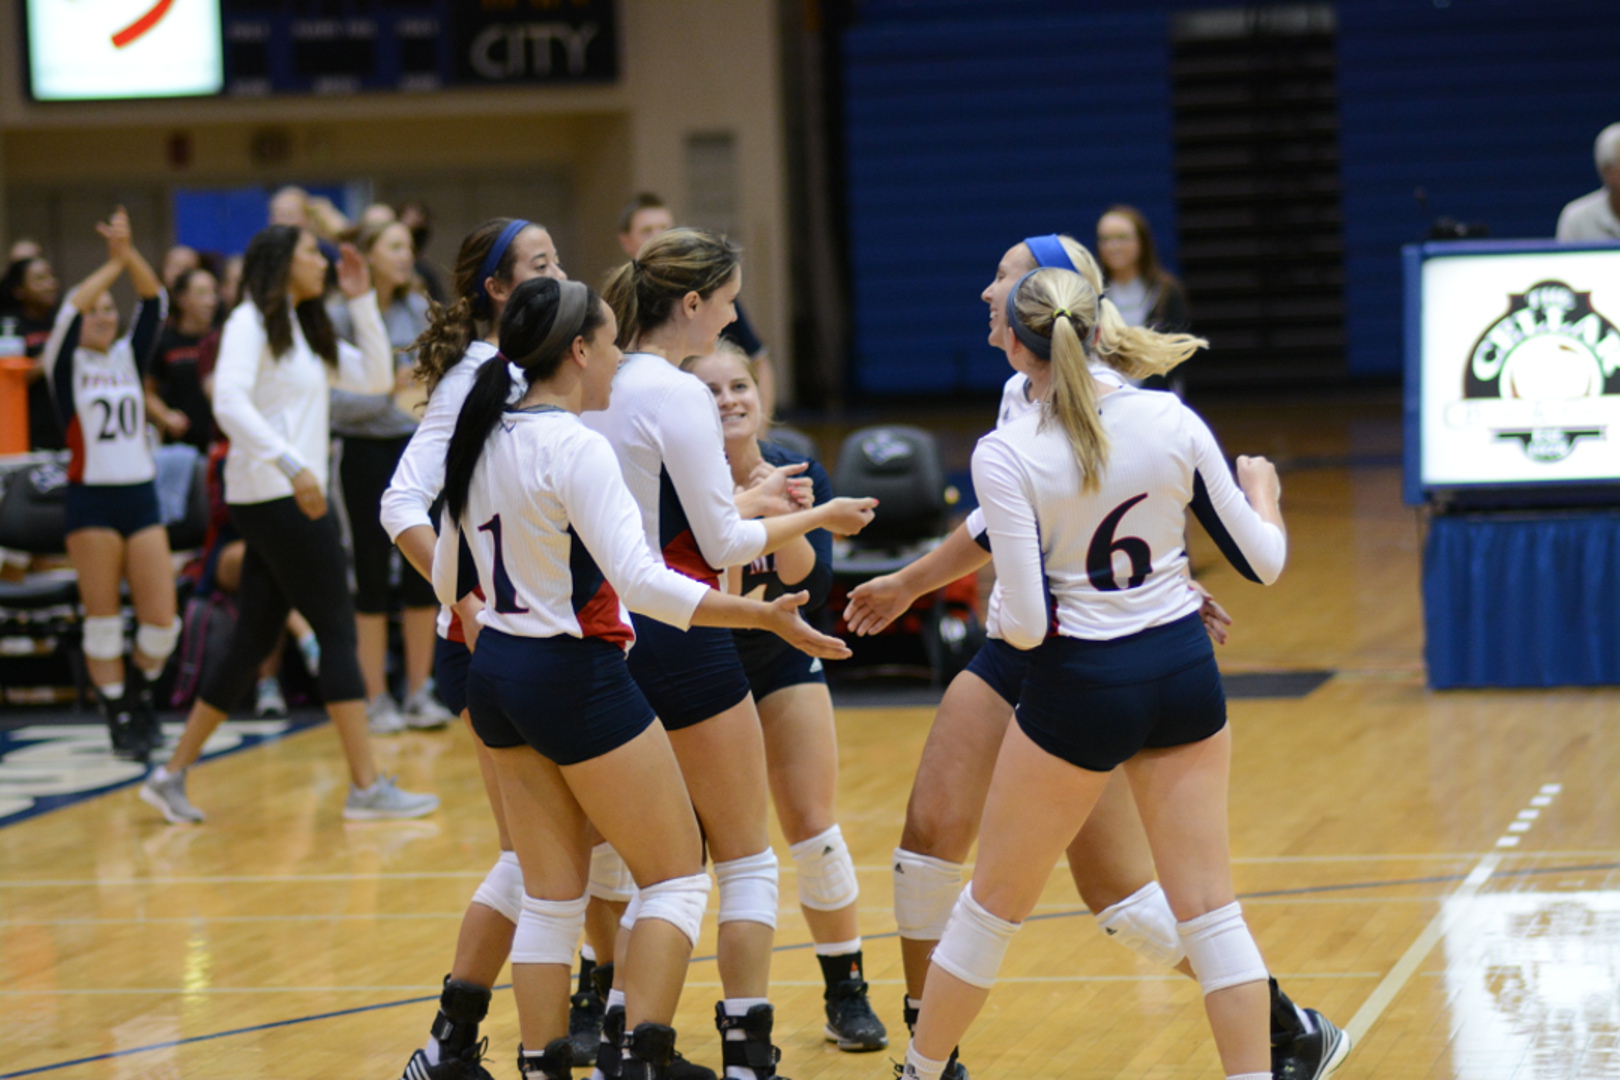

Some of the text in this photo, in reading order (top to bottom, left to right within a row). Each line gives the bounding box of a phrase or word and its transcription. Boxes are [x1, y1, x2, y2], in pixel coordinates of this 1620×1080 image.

[469, 23, 600, 79] CITY
[91, 396, 137, 442] 20
[477, 512, 530, 614] 1
[1086, 491, 1153, 592] 6
